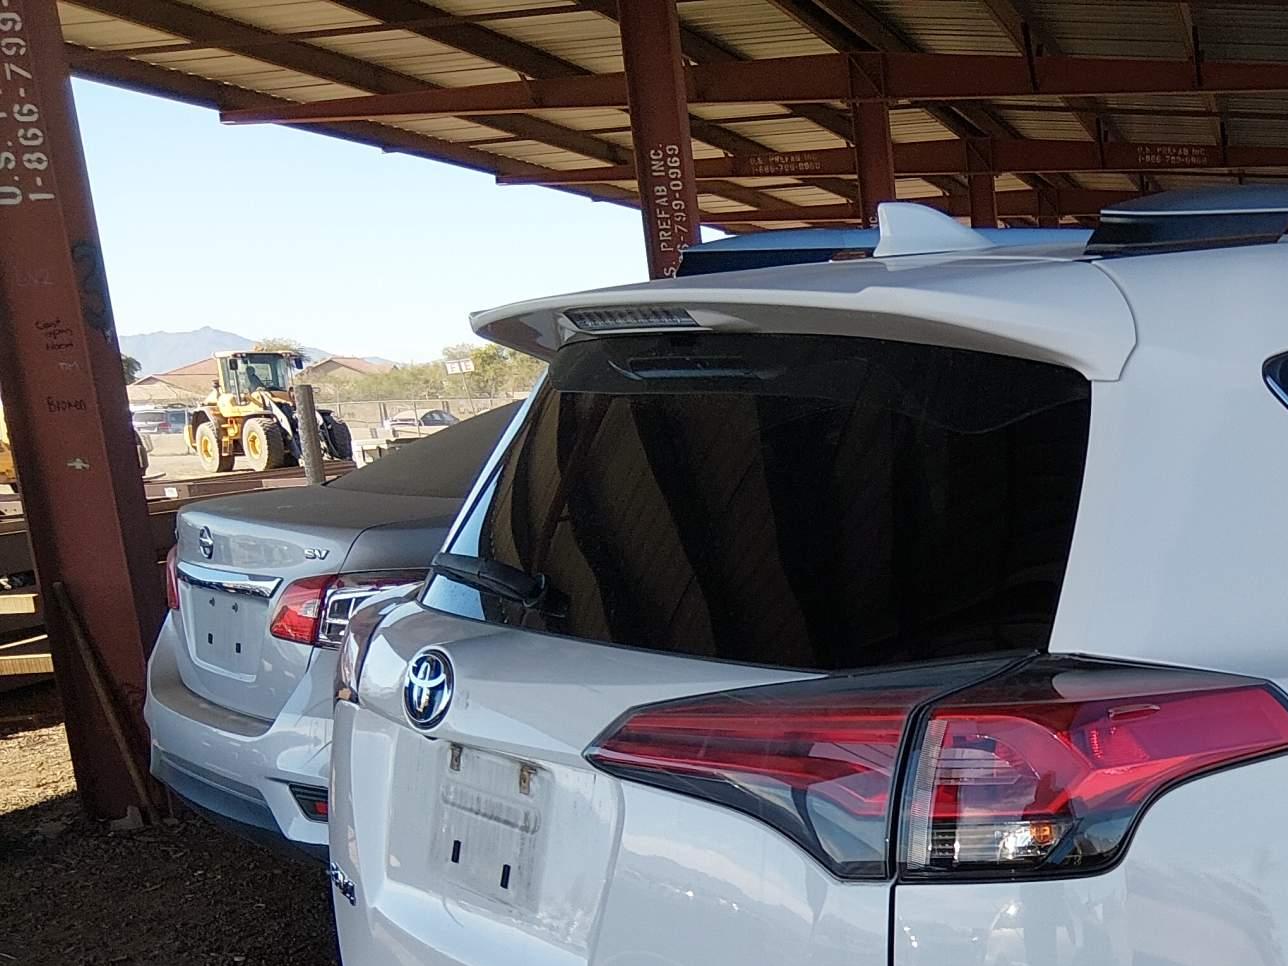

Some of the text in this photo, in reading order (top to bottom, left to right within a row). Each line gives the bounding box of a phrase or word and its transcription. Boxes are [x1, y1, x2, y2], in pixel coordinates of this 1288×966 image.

[650, 143, 666, 176] INC.
[654, 185, 674, 252] PREFAB
[304, 548, 330, 560] SV
